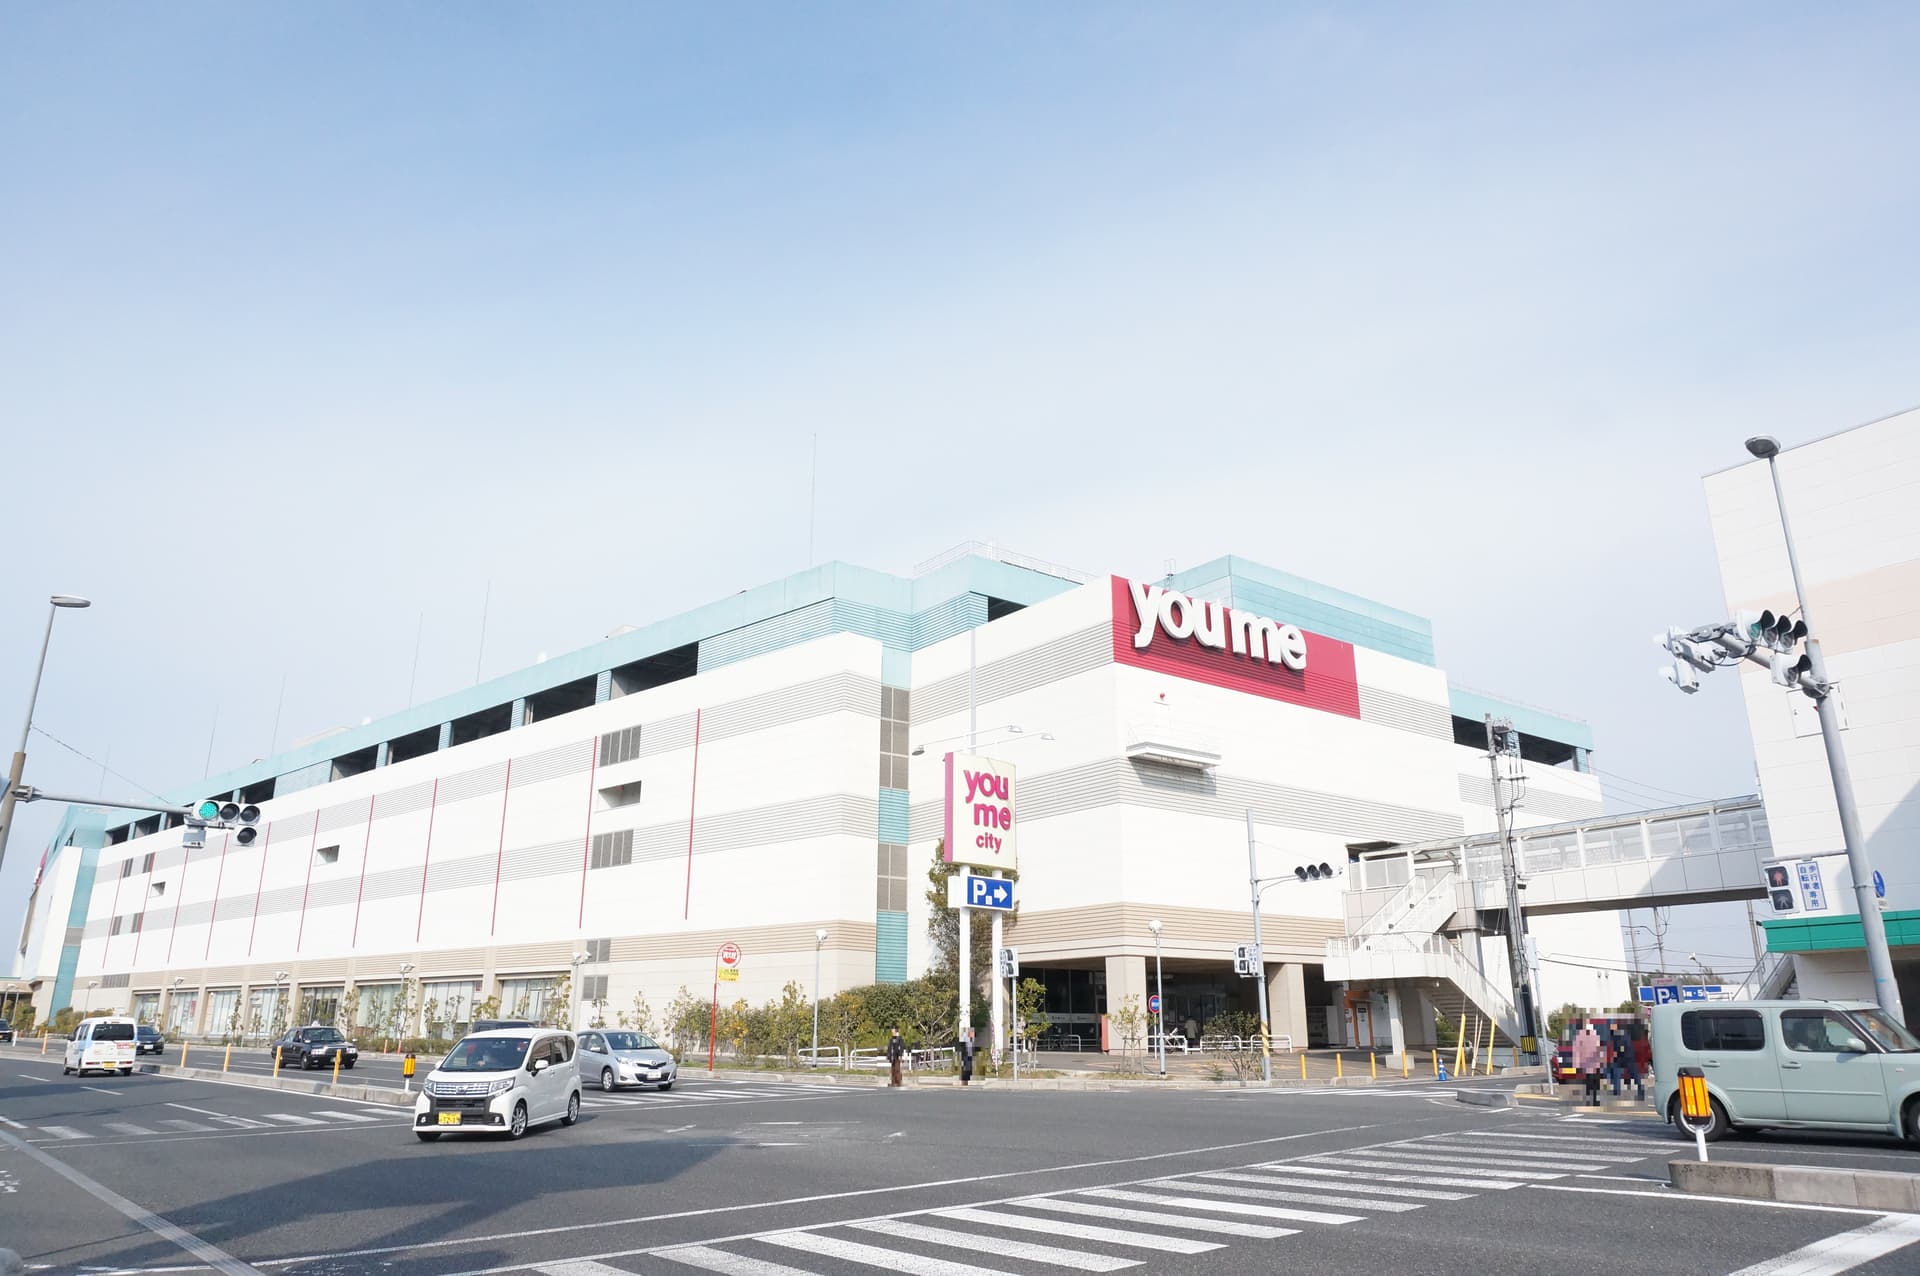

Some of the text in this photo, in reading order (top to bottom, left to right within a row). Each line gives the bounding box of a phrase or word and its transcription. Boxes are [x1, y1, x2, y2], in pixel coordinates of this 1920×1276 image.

[963, 769, 1009, 803] you
[974, 803, 1012, 830] me
[976, 832, 1002, 853] city
[1657, 988, 1670, 1005] P
